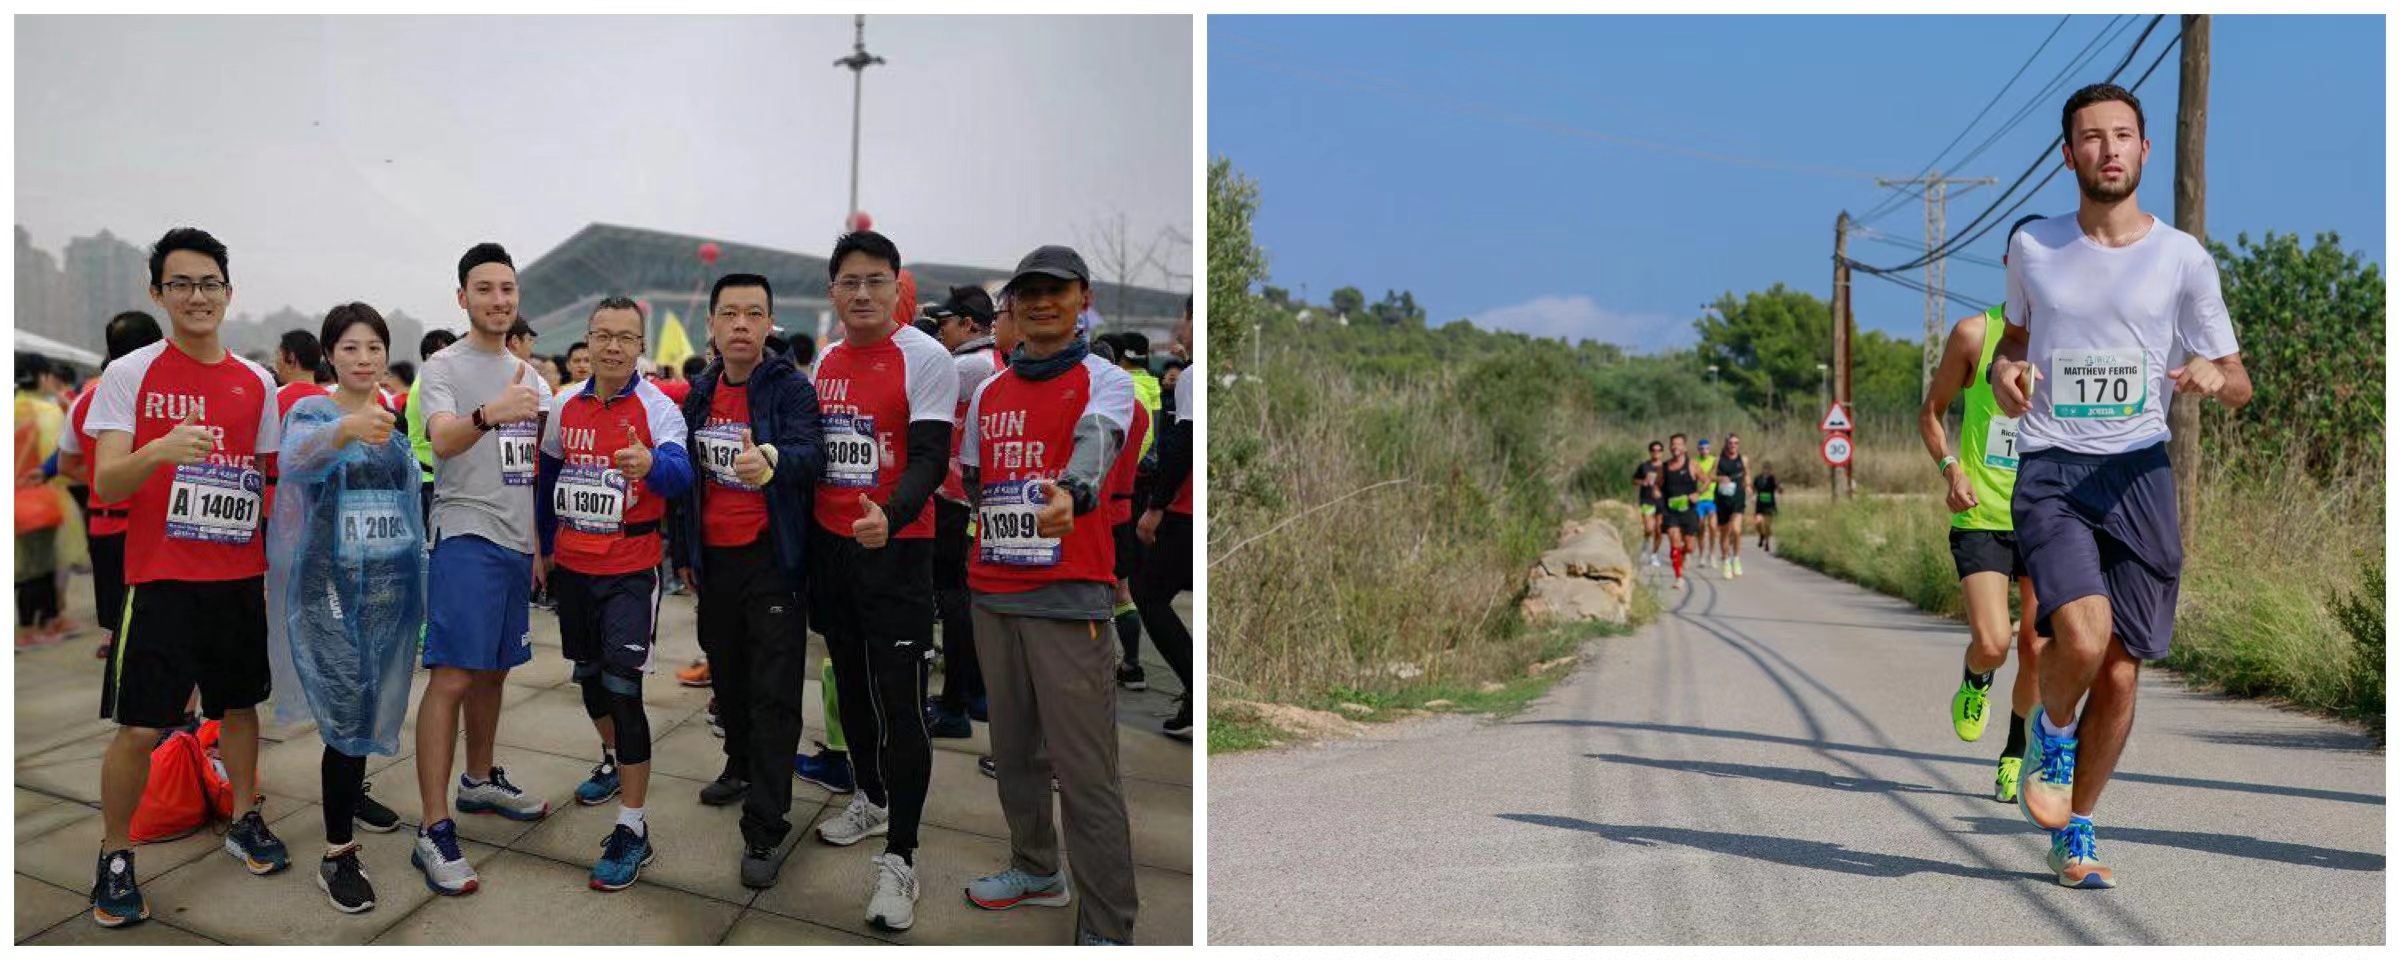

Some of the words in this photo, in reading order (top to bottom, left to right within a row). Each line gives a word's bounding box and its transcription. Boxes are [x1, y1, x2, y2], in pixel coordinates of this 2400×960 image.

[2064, 367, 2106, 375] MATTHEW
[2108, 366, 2138, 375] FERTIG
[2075, 378, 2128, 403] 170
[145, 391, 206, 421] RUN
[505, 441, 515, 465] A
[993, 441, 1046, 472] FOR
[1829, 444, 1847, 456] 30
[173, 487, 188, 516] A
[201, 493, 254, 521] 14081
[556, 487, 567, 511] A
[573, 490, 615, 516] 13077
[345, 516, 359, 541] A
